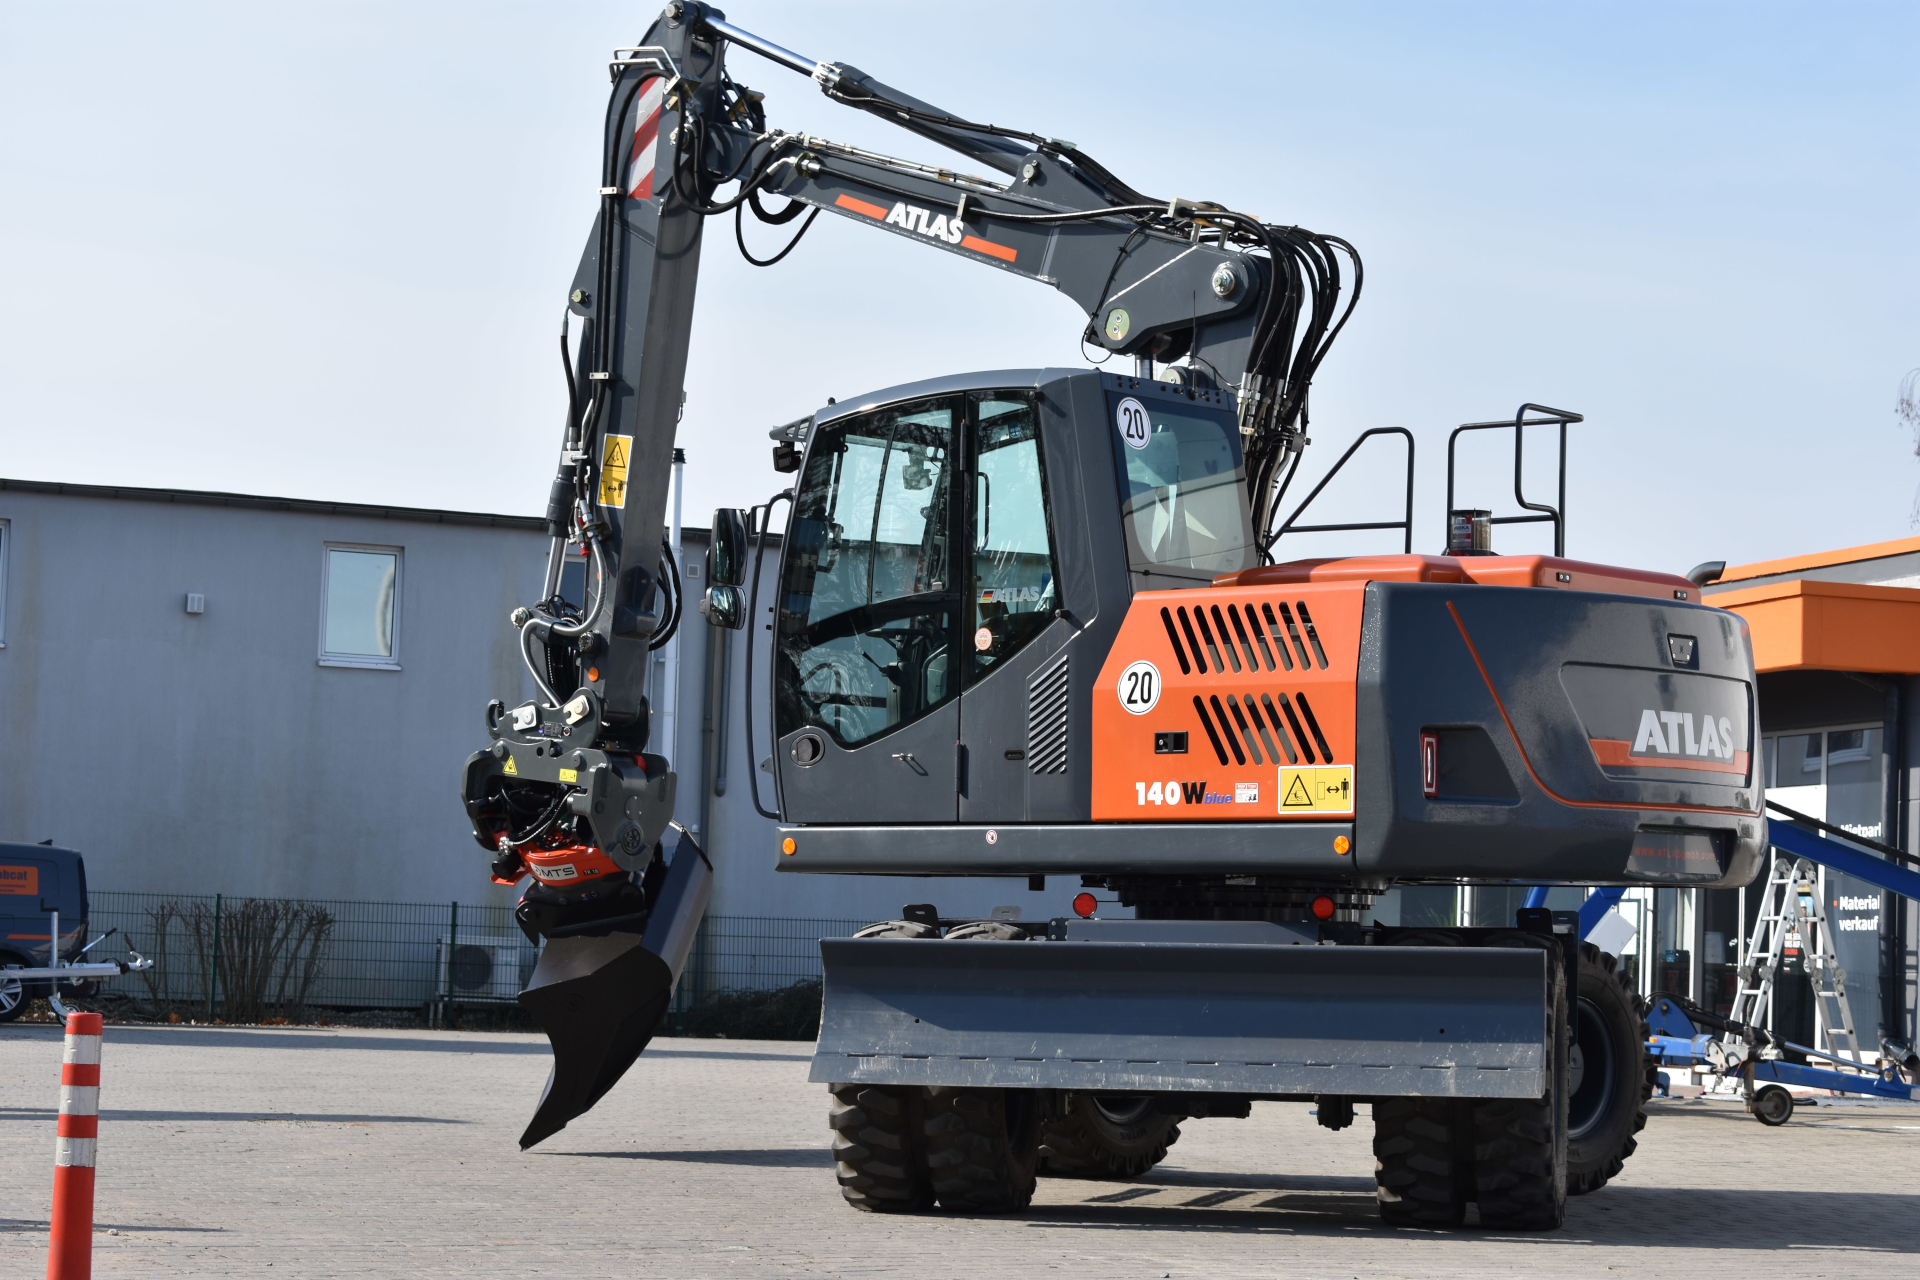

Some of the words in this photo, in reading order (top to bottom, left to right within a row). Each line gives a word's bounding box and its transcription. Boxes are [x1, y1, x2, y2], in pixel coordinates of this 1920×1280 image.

[885, 201, 964, 244] ATLAS
[1123, 407, 1145, 440] 20
[992, 587, 1039, 603] ATLAS
[1127, 671, 1152, 704] 20
[1633, 709, 1734, 759] ATLAS
[1204, 791, 1233, 804] blue
[0, 870, 27, 880] bcat
[541, 867, 575, 877] MTS
[1839, 895, 1880, 911] Material
[1839, 915, 1879, 931] verkauf
